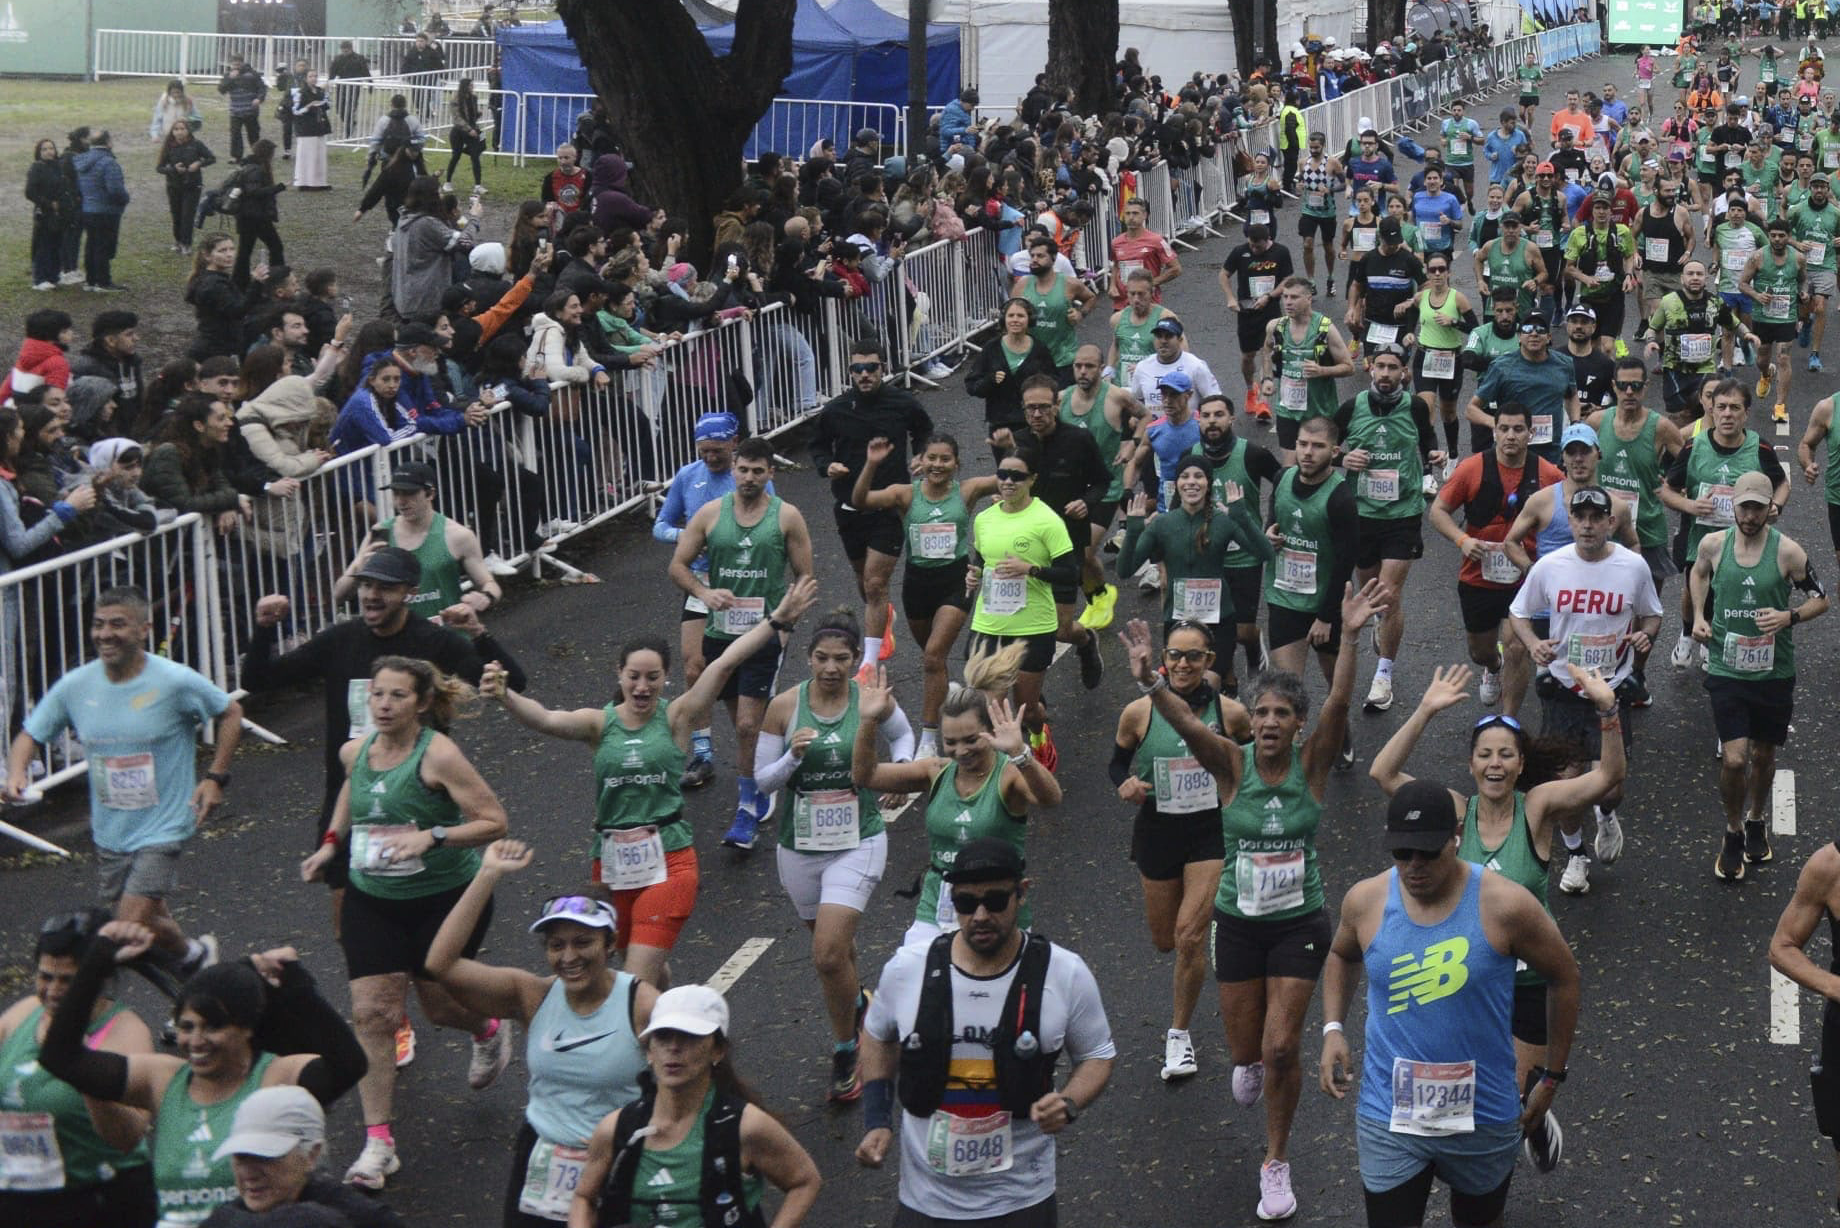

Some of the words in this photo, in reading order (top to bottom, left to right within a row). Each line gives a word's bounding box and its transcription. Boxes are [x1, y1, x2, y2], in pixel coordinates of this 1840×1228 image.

[1600, 473, 1641, 489] personal
[719, 566, 769, 580] personal
[1556, 588, 1624, 617] PERU
[1175, 771, 1211, 794] 7893
[815, 806, 853, 830] 6836
[1257, 867, 1299, 893] 7121
[1415, 1084, 1473, 1109] 12344
[953, 1134, 1004, 1165] 6848
[555, 1163, 578, 1193] 73
